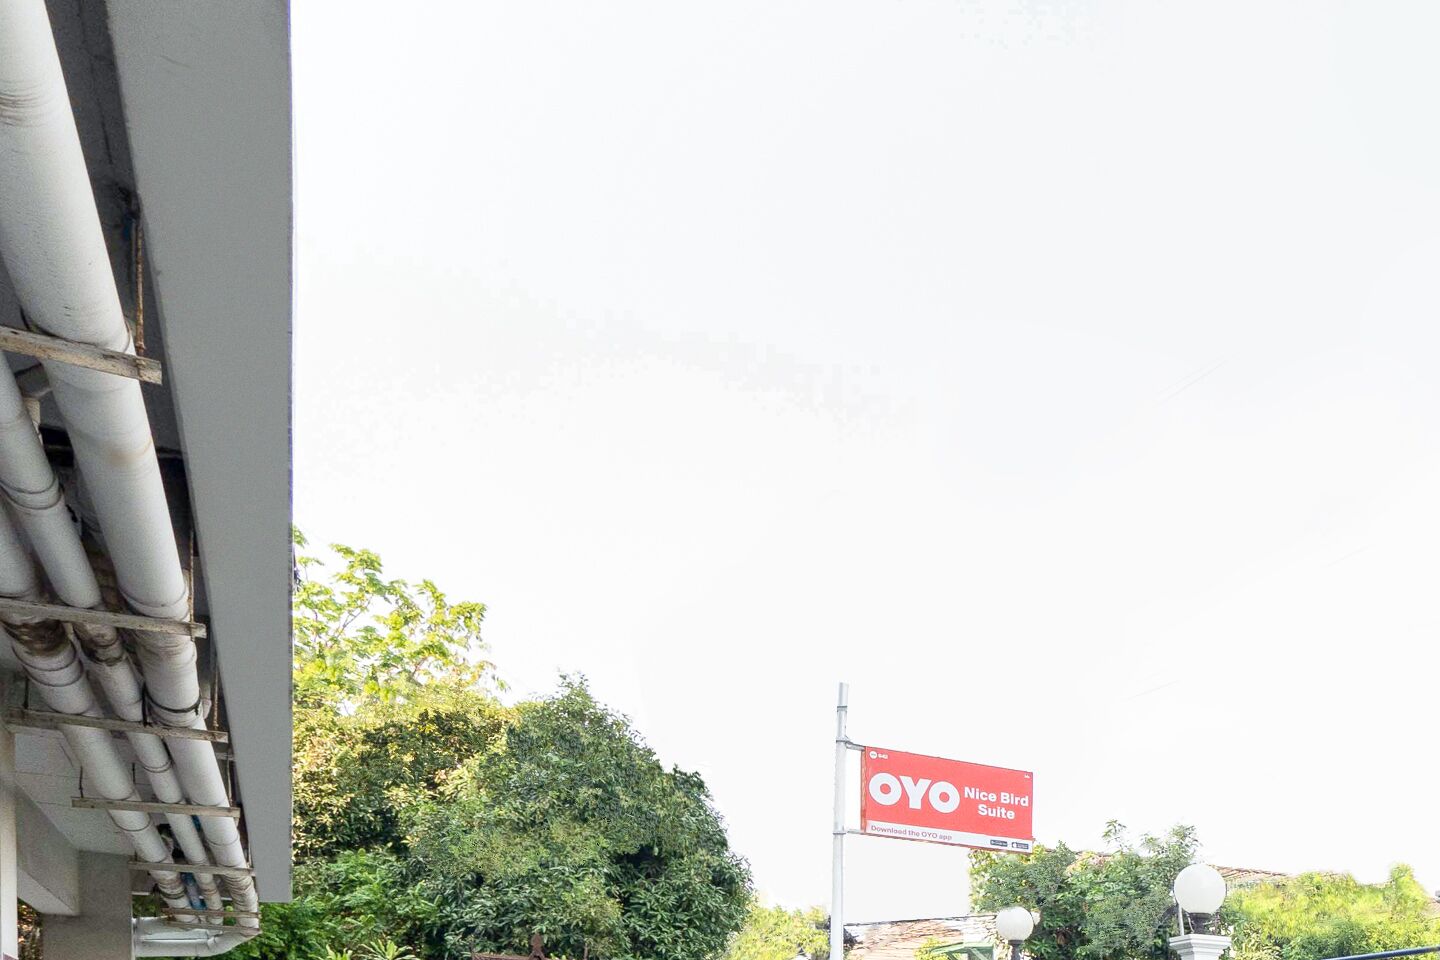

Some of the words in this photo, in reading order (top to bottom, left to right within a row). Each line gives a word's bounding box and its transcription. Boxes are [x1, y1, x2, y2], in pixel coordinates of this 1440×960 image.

[869, 772, 960, 814] OYO
[964, 786, 997, 802] Nice
[1000, 792, 1029, 807] Bird
[978, 804, 1016, 820] Suite
[871, 825, 907, 835] Download
[921, 831, 938, 839] OYO
